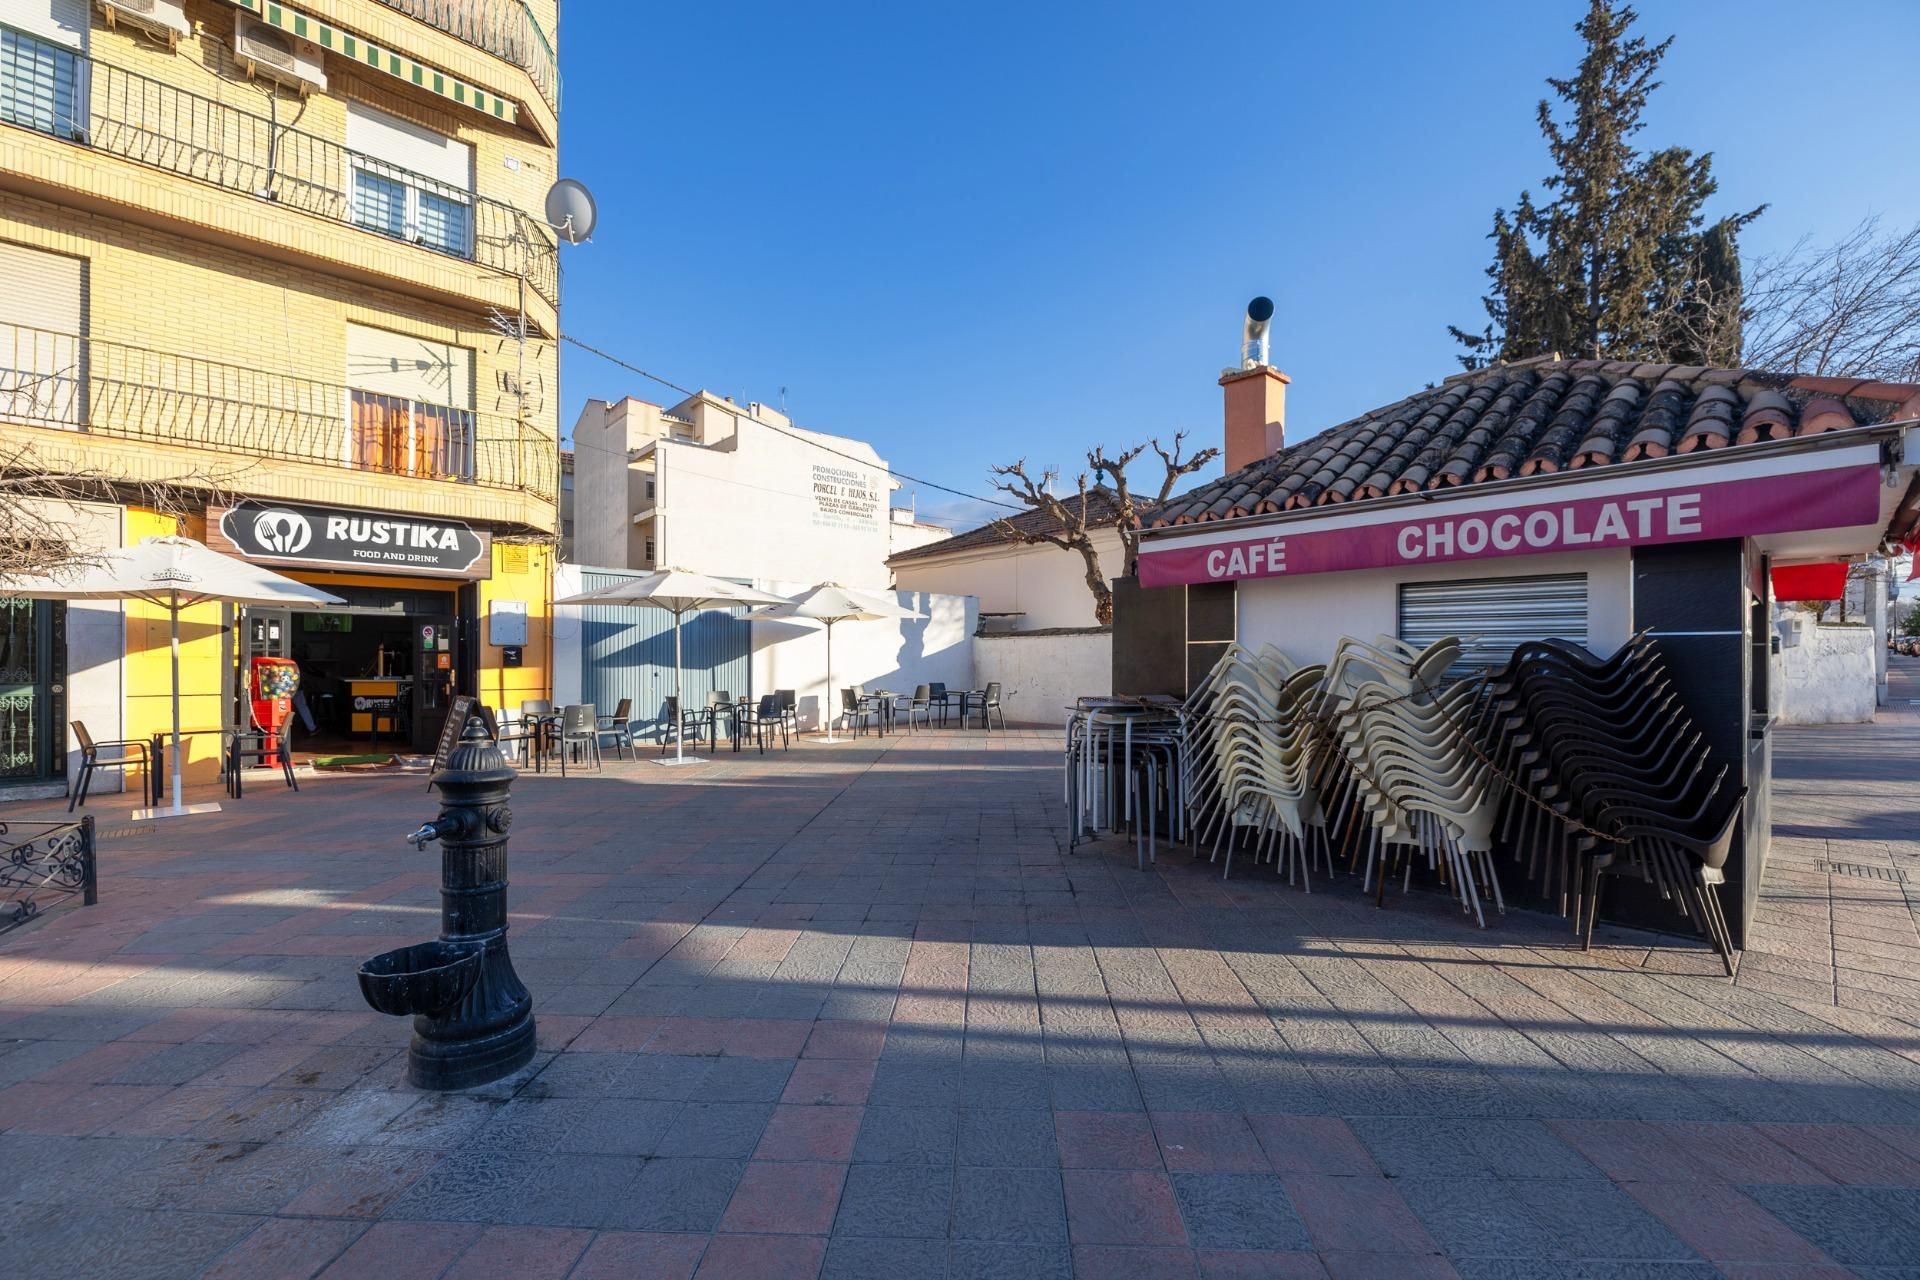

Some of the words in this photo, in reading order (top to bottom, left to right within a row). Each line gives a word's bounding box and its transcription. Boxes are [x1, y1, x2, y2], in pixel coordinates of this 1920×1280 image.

[812, 465, 858, 479] PROMOCIONES
[812, 473, 867, 488] CONSTRUCCIONES
[813, 482, 837, 495] PORCEL
[841, 487, 845, 496] E
[838, 509, 873, 519] COMERCIALES
[326, 515, 459, 551] RUSTIKA
[1397, 493, 1703, 560] CHOCOLATE
[353, 549, 381, 559] FOOD
[382, 552, 406, 561] AND
[407, 553, 439, 564] DRINK
[1206, 537, 1287, 578] CAFÉ
